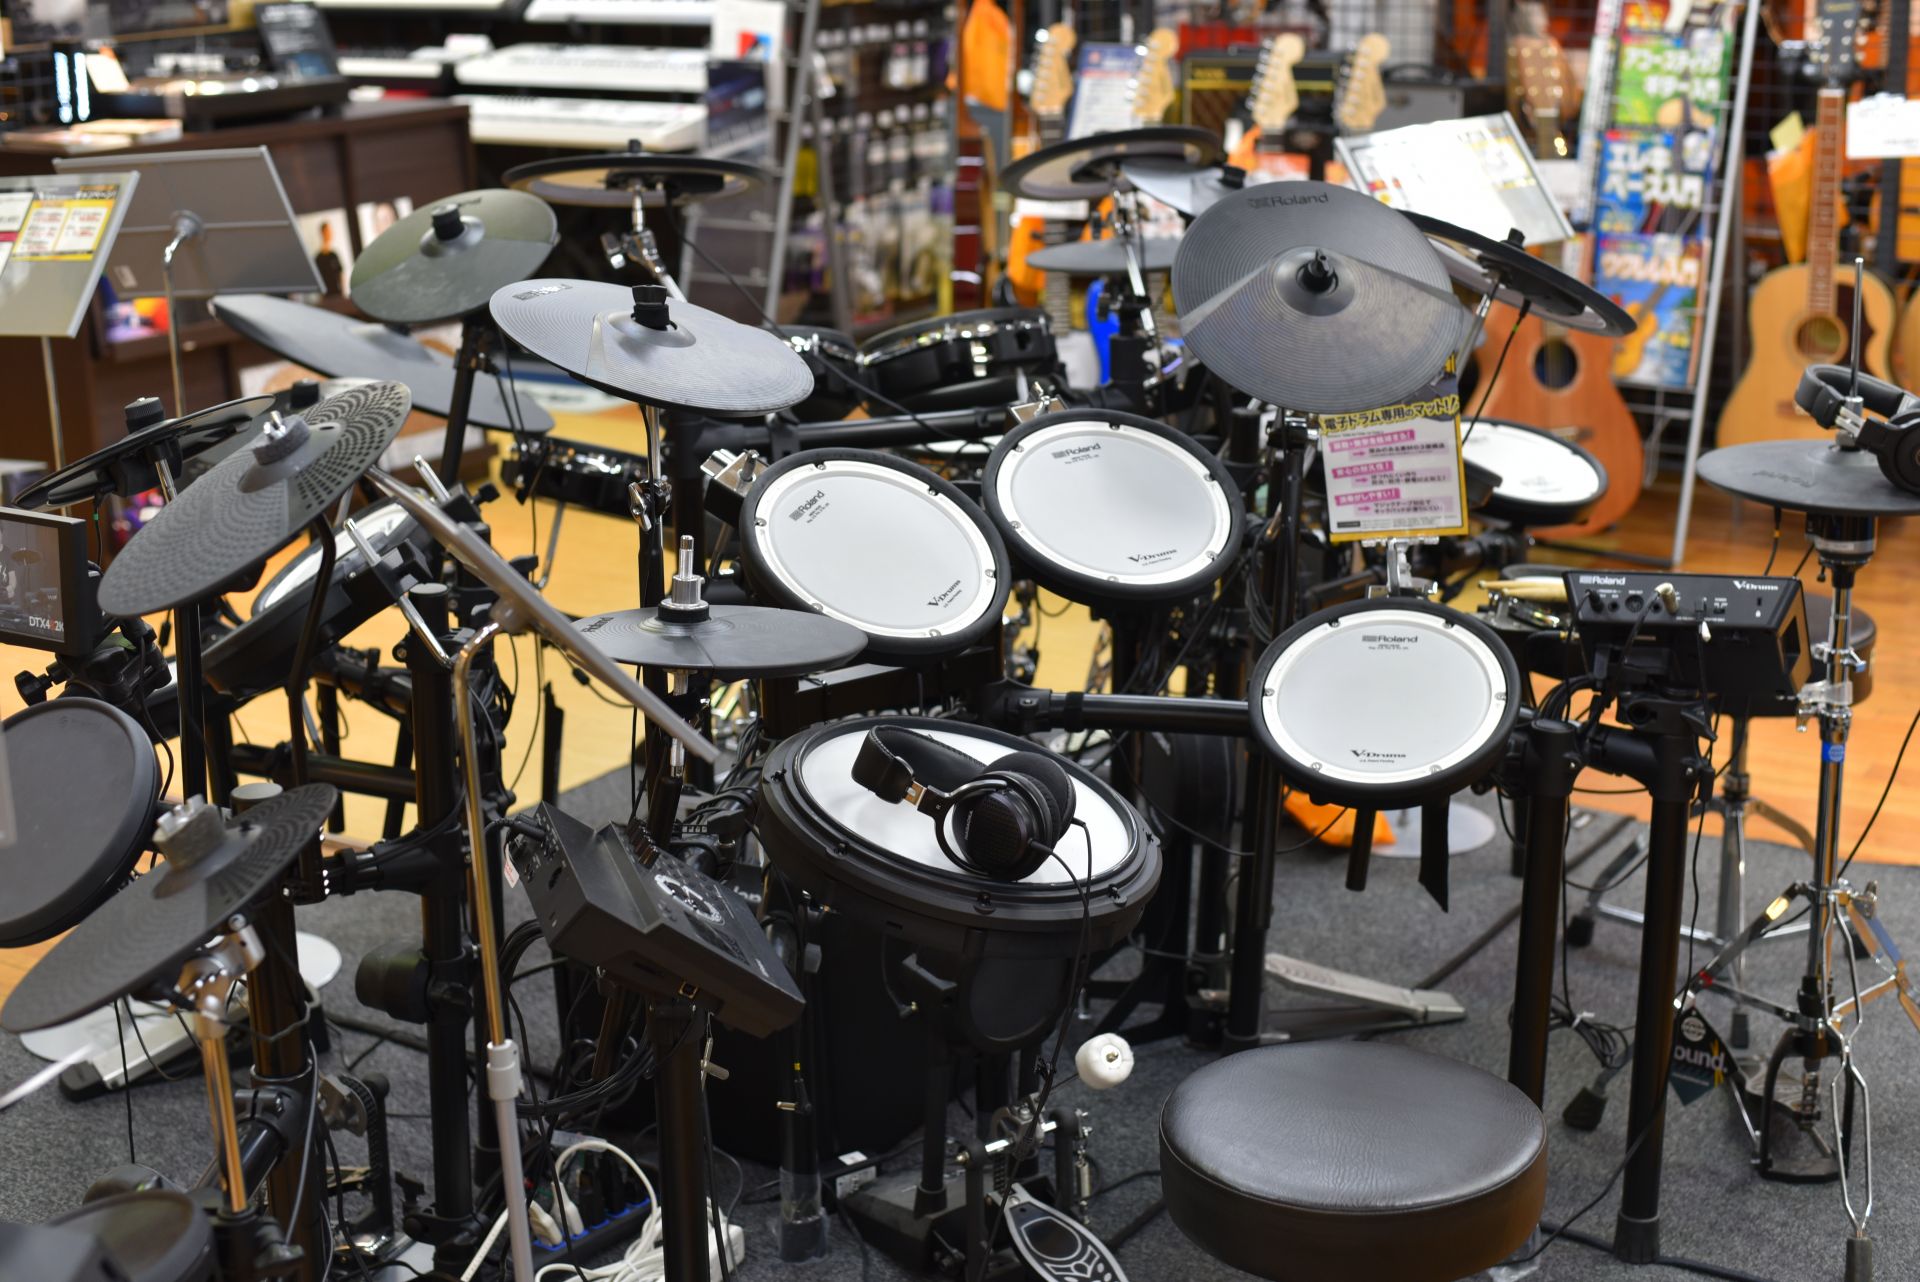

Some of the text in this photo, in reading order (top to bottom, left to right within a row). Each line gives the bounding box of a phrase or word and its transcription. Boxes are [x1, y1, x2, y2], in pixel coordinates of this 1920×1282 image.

[1271, 191, 1328, 207] Roland
[1065, 443, 1101, 456] Roland
[798, 489, 825, 514] Roland
[1593, 576, 1626, 586] Roland
[1378, 635, 1418, 643] Roland
[1674, 1045, 1727, 1073] ound.
